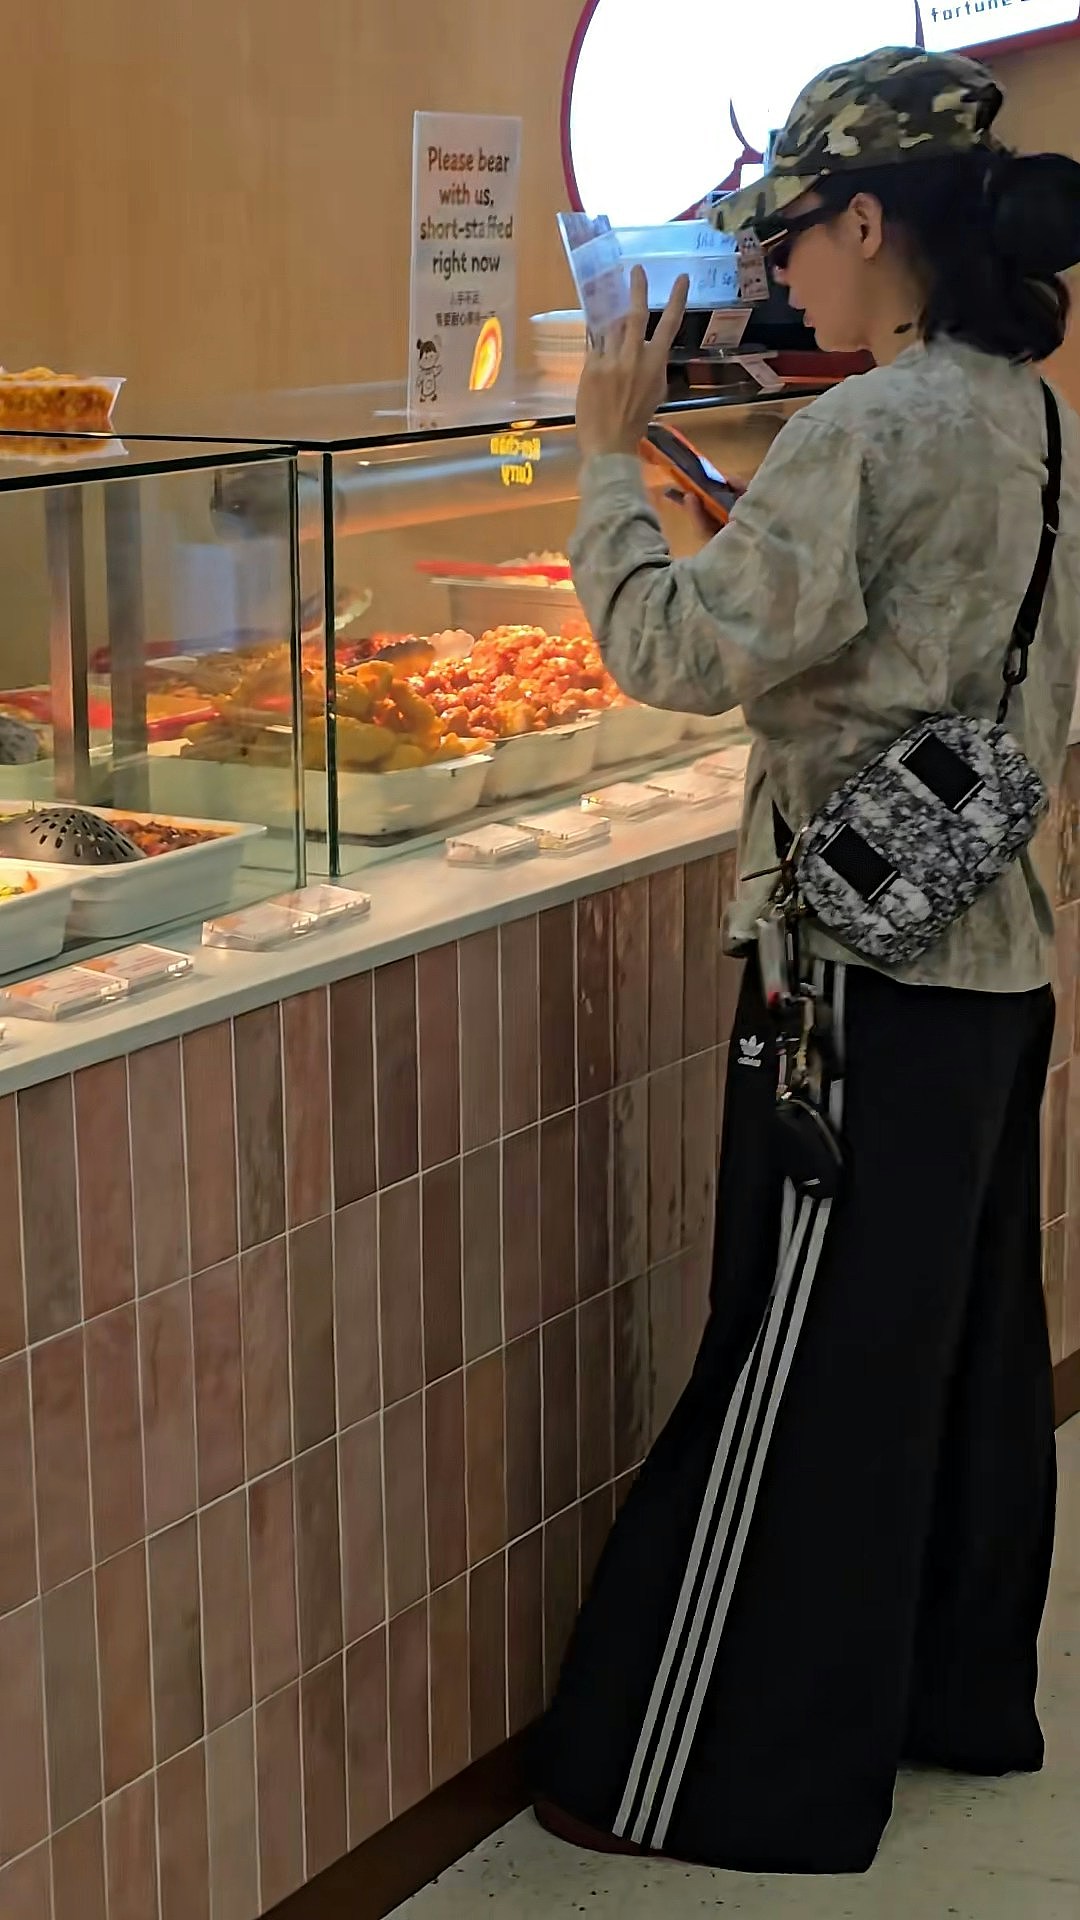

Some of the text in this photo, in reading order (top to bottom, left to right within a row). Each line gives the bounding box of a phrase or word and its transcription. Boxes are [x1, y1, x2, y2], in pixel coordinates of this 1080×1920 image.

[428, 146, 509, 173] Please bear
[439, 182, 470, 206] with
[420, 215, 513, 240] short-staffed
[433, 249, 500, 280] right now
